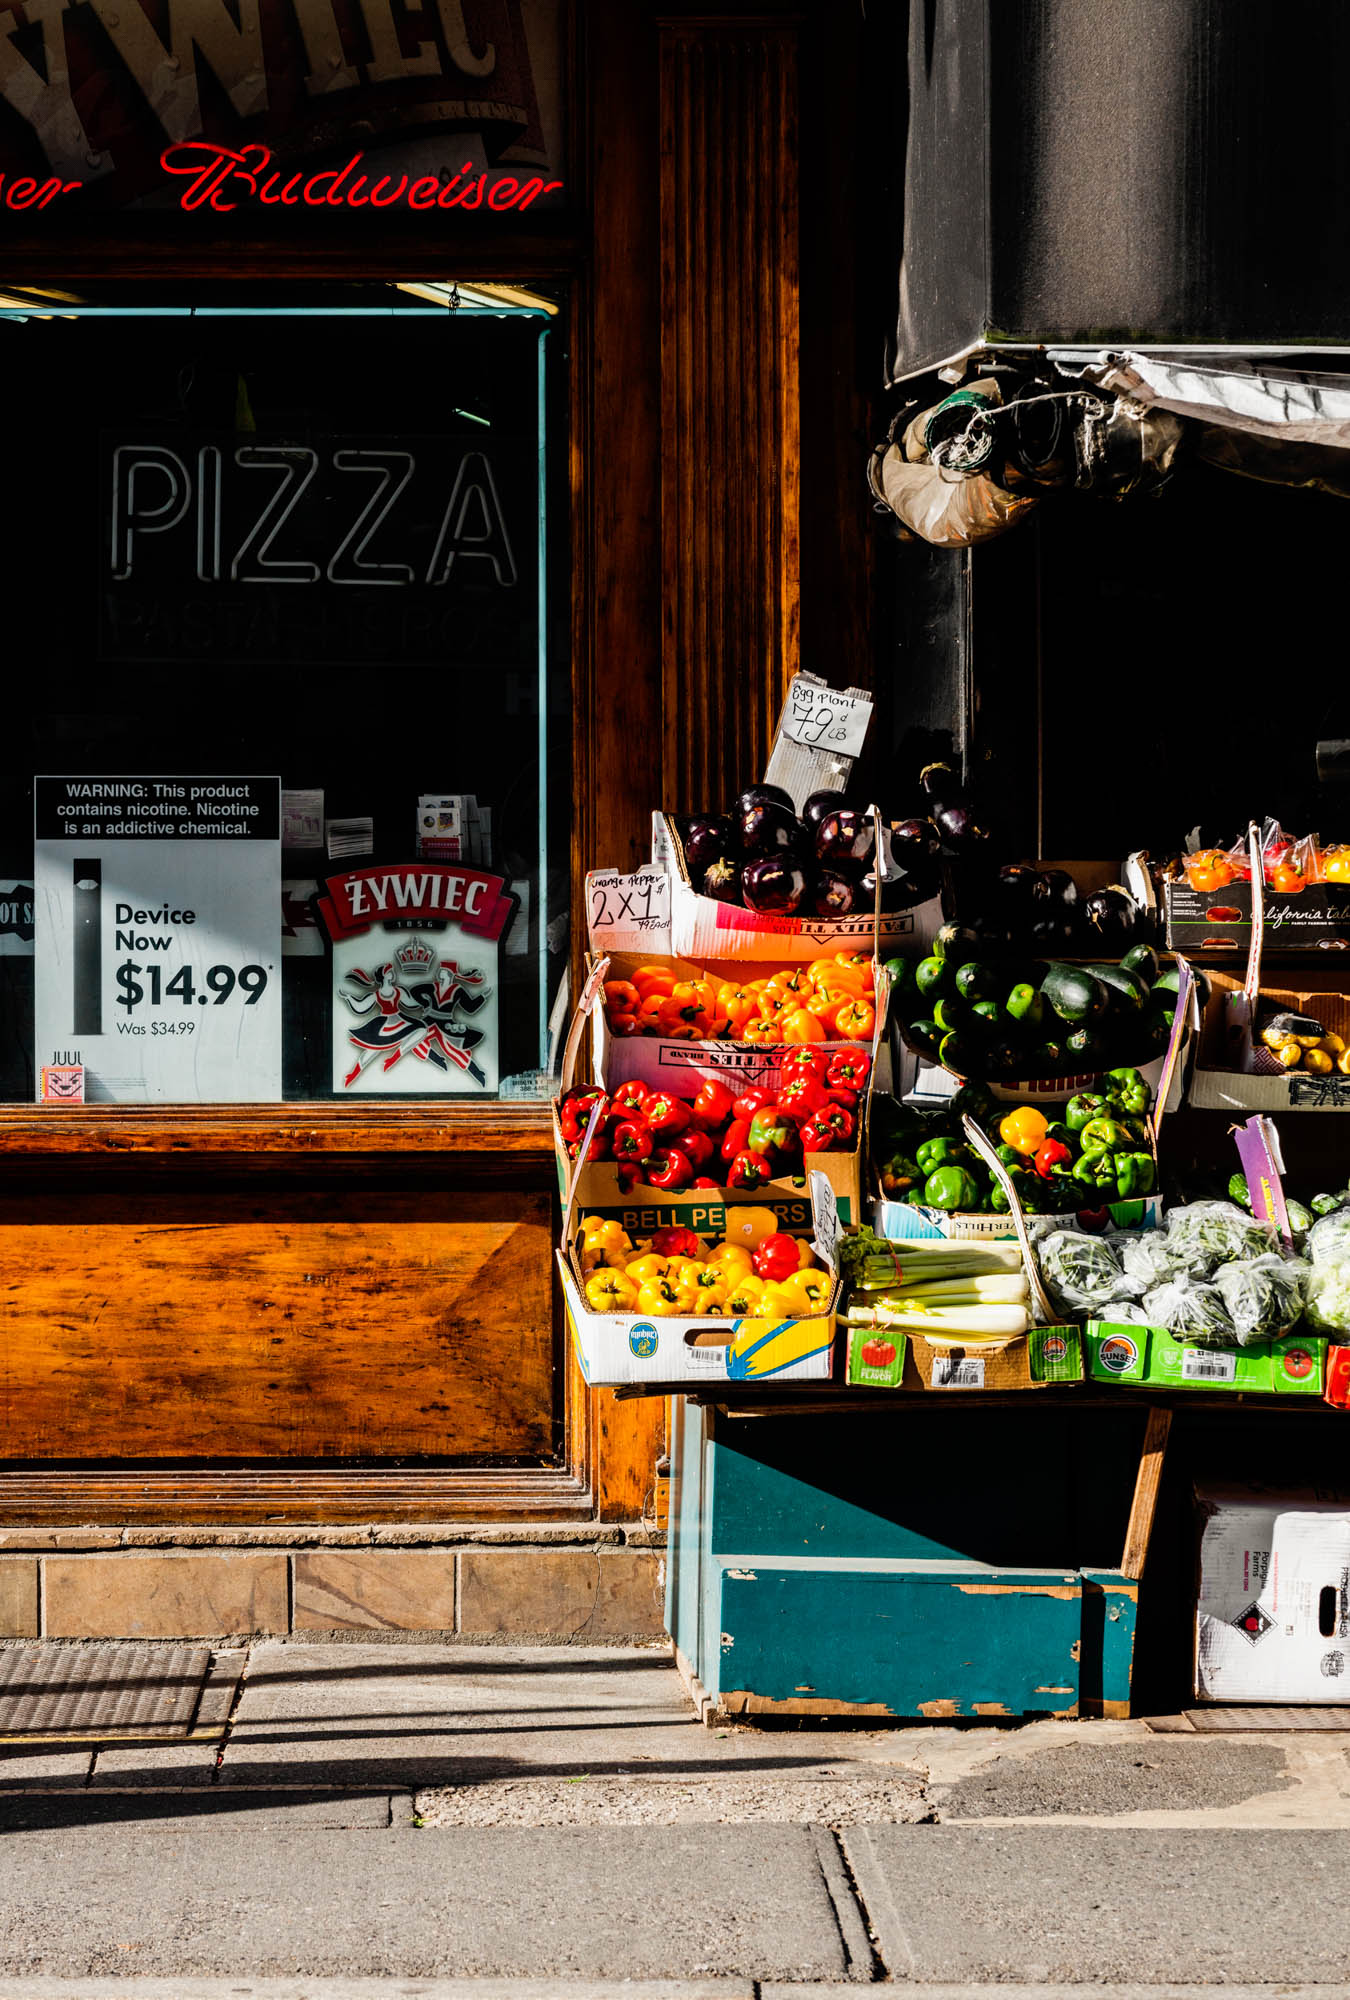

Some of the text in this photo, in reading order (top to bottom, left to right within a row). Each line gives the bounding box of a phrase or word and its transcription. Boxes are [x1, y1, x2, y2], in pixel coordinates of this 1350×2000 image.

[160, 142, 564, 211] Budweiser
[0, 173, 82, 210] er
[111, 445, 519, 587] PIZZA
[792, 685, 814, 703] Egg
[66, 783, 250, 801] WARNING: This product
[57, 802, 260, 816] contains nicotine. Nicotine
[64, 821, 251, 834] is an addictive chemical.
[344, 873, 488, 916] ŻYWIEC
[115, 903, 196, 925] Device
[1250, 905, 1324, 929] lifornia
[396, 920, 433, 929] 1856
[115, 930, 173, 951] Now
[116, 1021, 196, 1036] Was $34.99
[51, 1051, 83, 1066] JUUL
[670, 1051, 704, 1060] BRAND
[709, 1054, 755, 1067] TIES
[623, 1203, 806, 1230] BELL PERS
[1100, 1352, 1137, 1365] SUNSET
